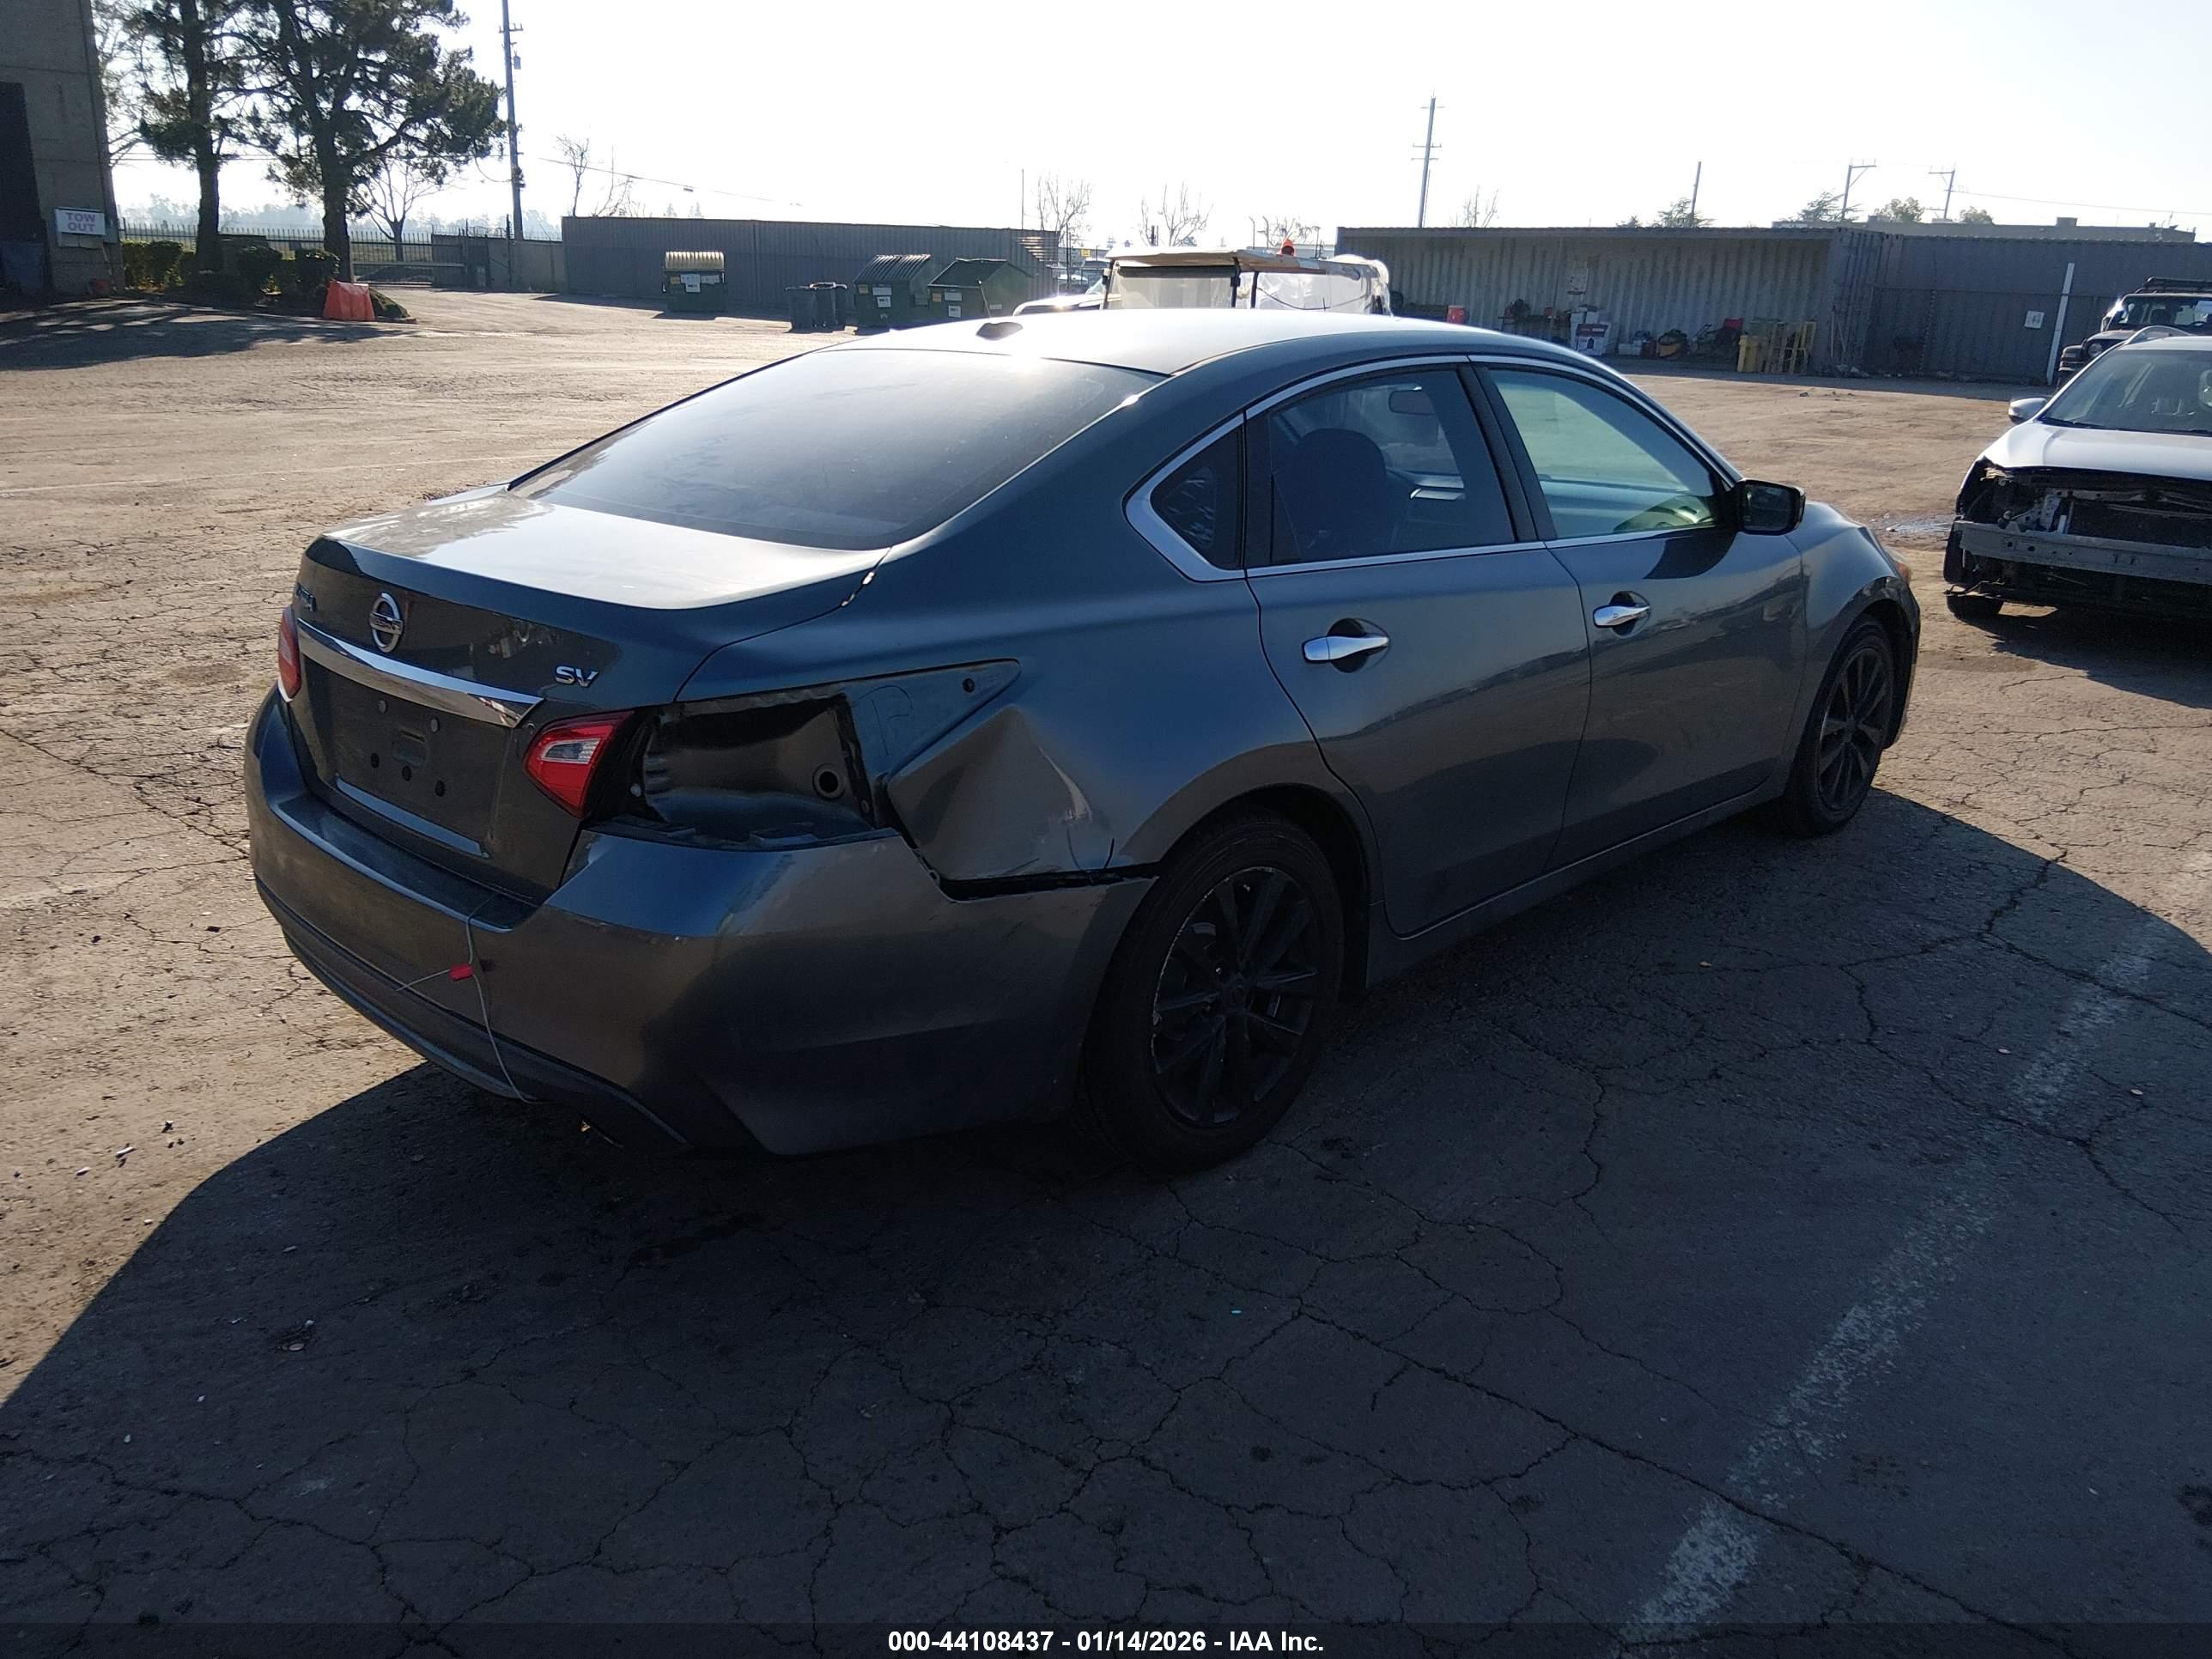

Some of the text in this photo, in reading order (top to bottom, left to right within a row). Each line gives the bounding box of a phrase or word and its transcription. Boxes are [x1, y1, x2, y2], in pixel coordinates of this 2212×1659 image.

[66, 212, 95, 222] TOW
[68, 222, 95, 232] OUT
[555, 665, 599, 688] SV
